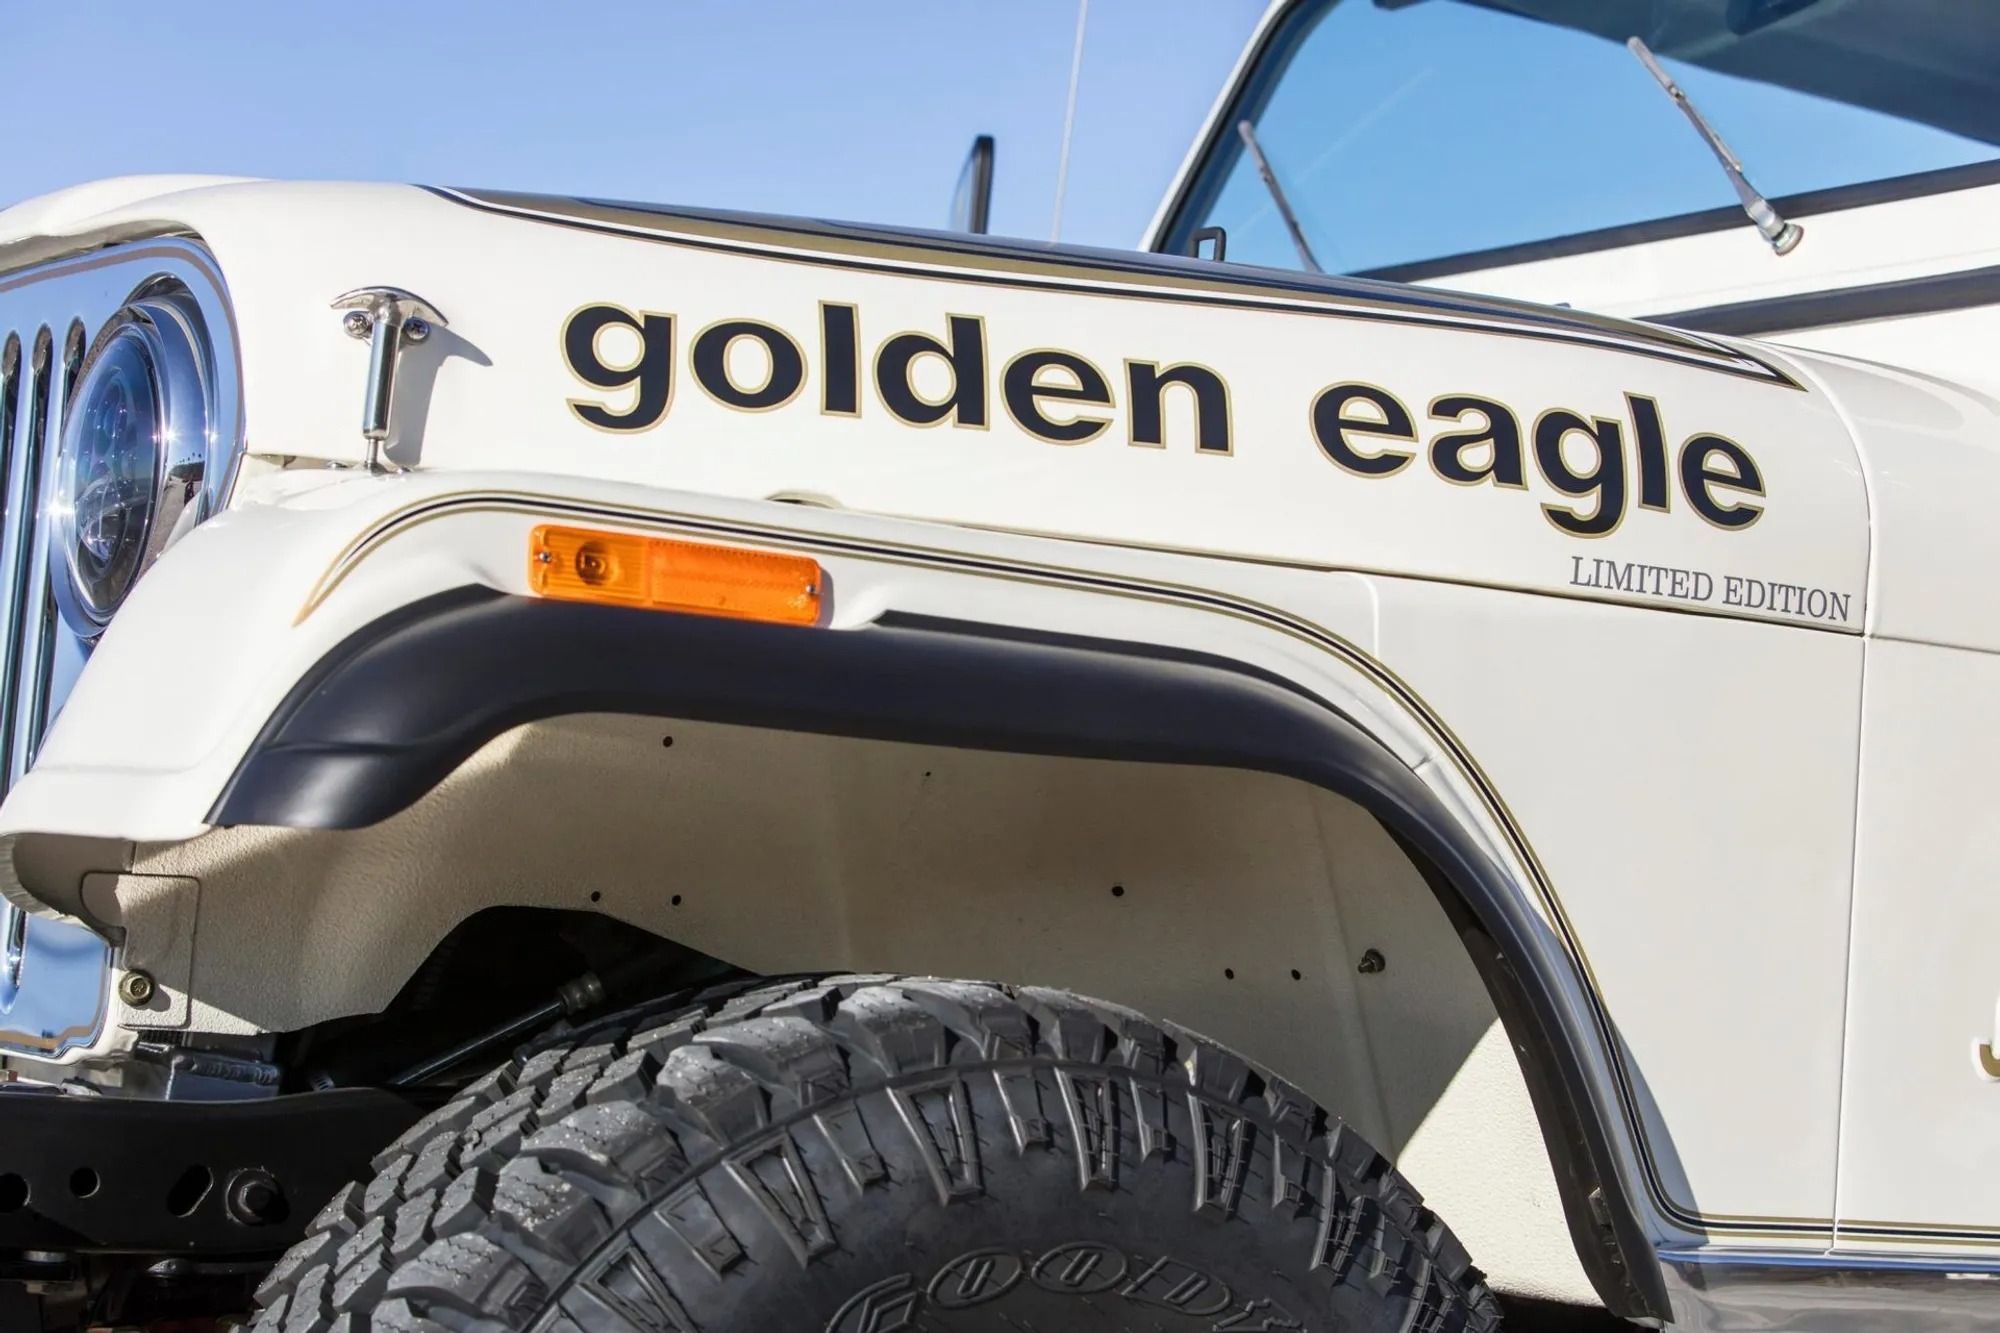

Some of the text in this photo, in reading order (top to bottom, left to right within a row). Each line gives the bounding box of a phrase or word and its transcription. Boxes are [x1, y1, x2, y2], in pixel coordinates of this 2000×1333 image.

[560, 300, 1767, 539] golden eagle
[1569, 555, 1852, 622] LIMITED EDITION
